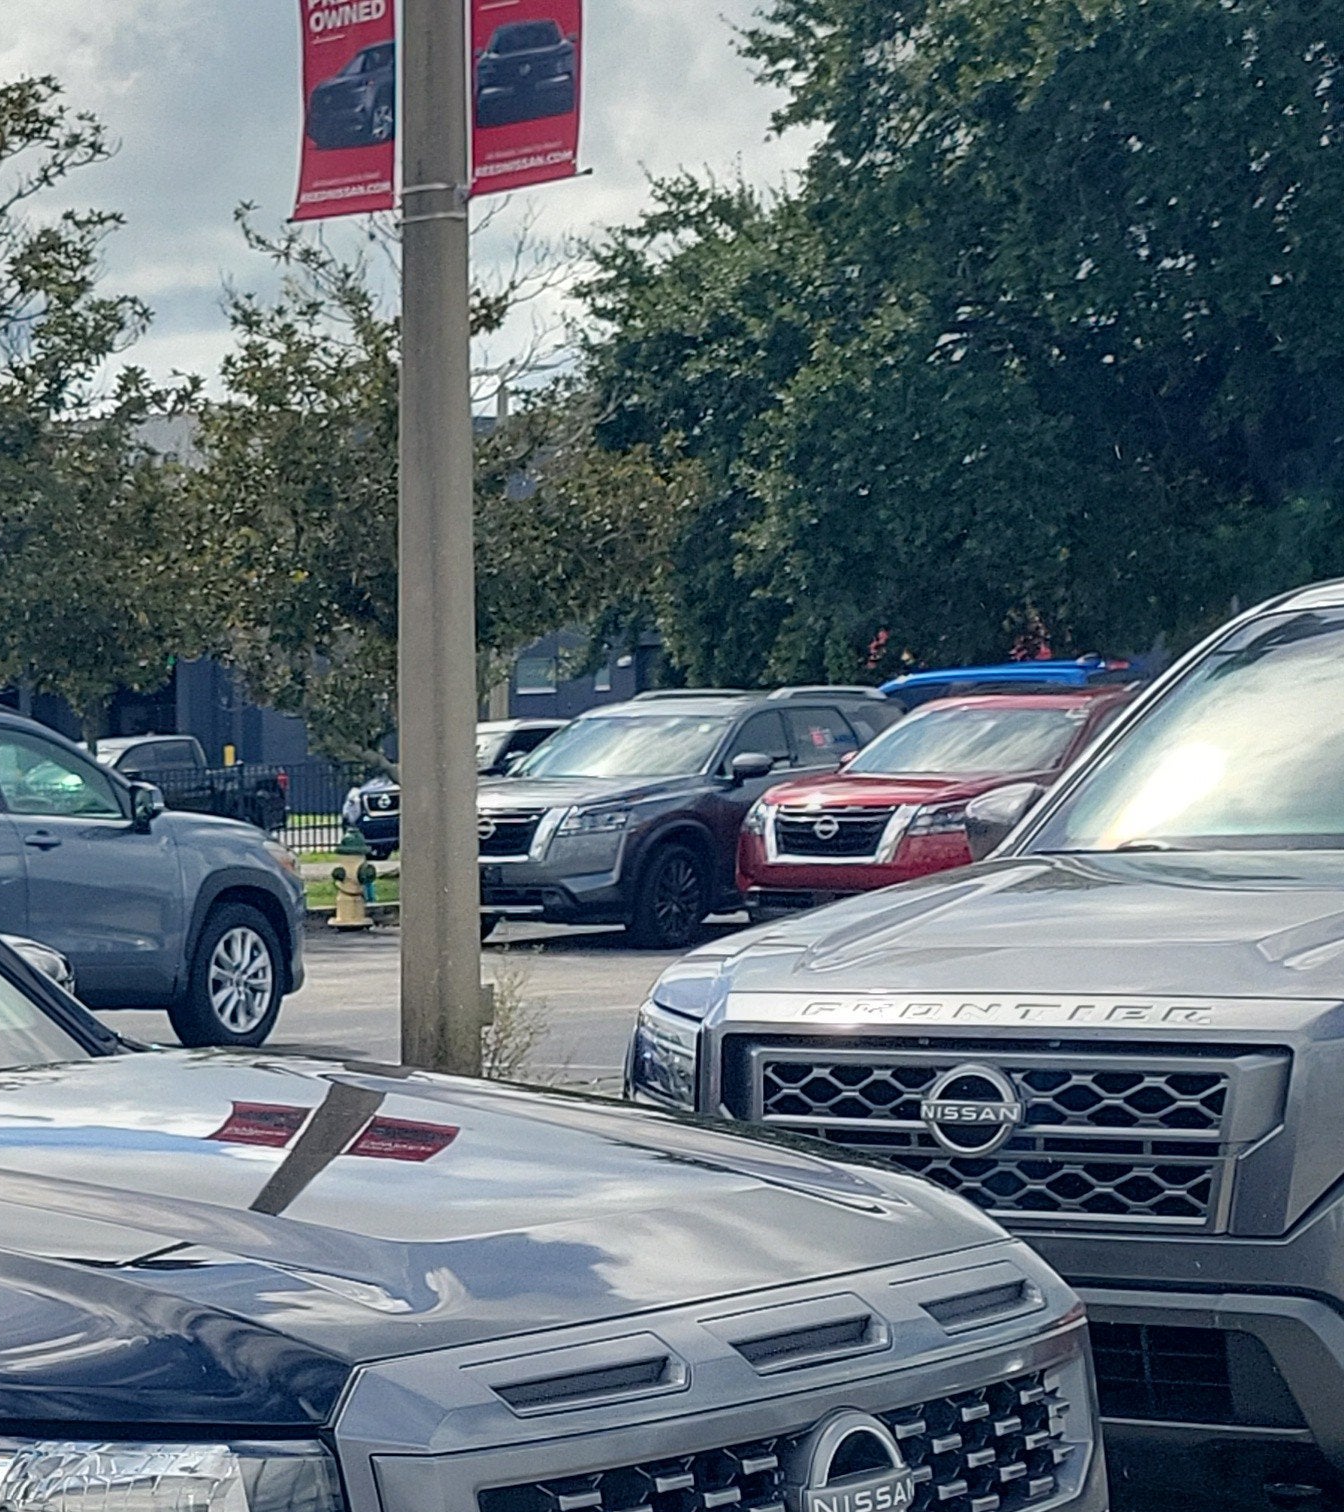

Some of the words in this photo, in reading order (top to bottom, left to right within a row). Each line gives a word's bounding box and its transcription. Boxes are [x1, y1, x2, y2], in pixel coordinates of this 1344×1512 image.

[309, 1, 386, 33] OWNED
[800, 1001, 1212, 1025] FRONTIER
[920, 1105, 1018, 1122] NISSAN
